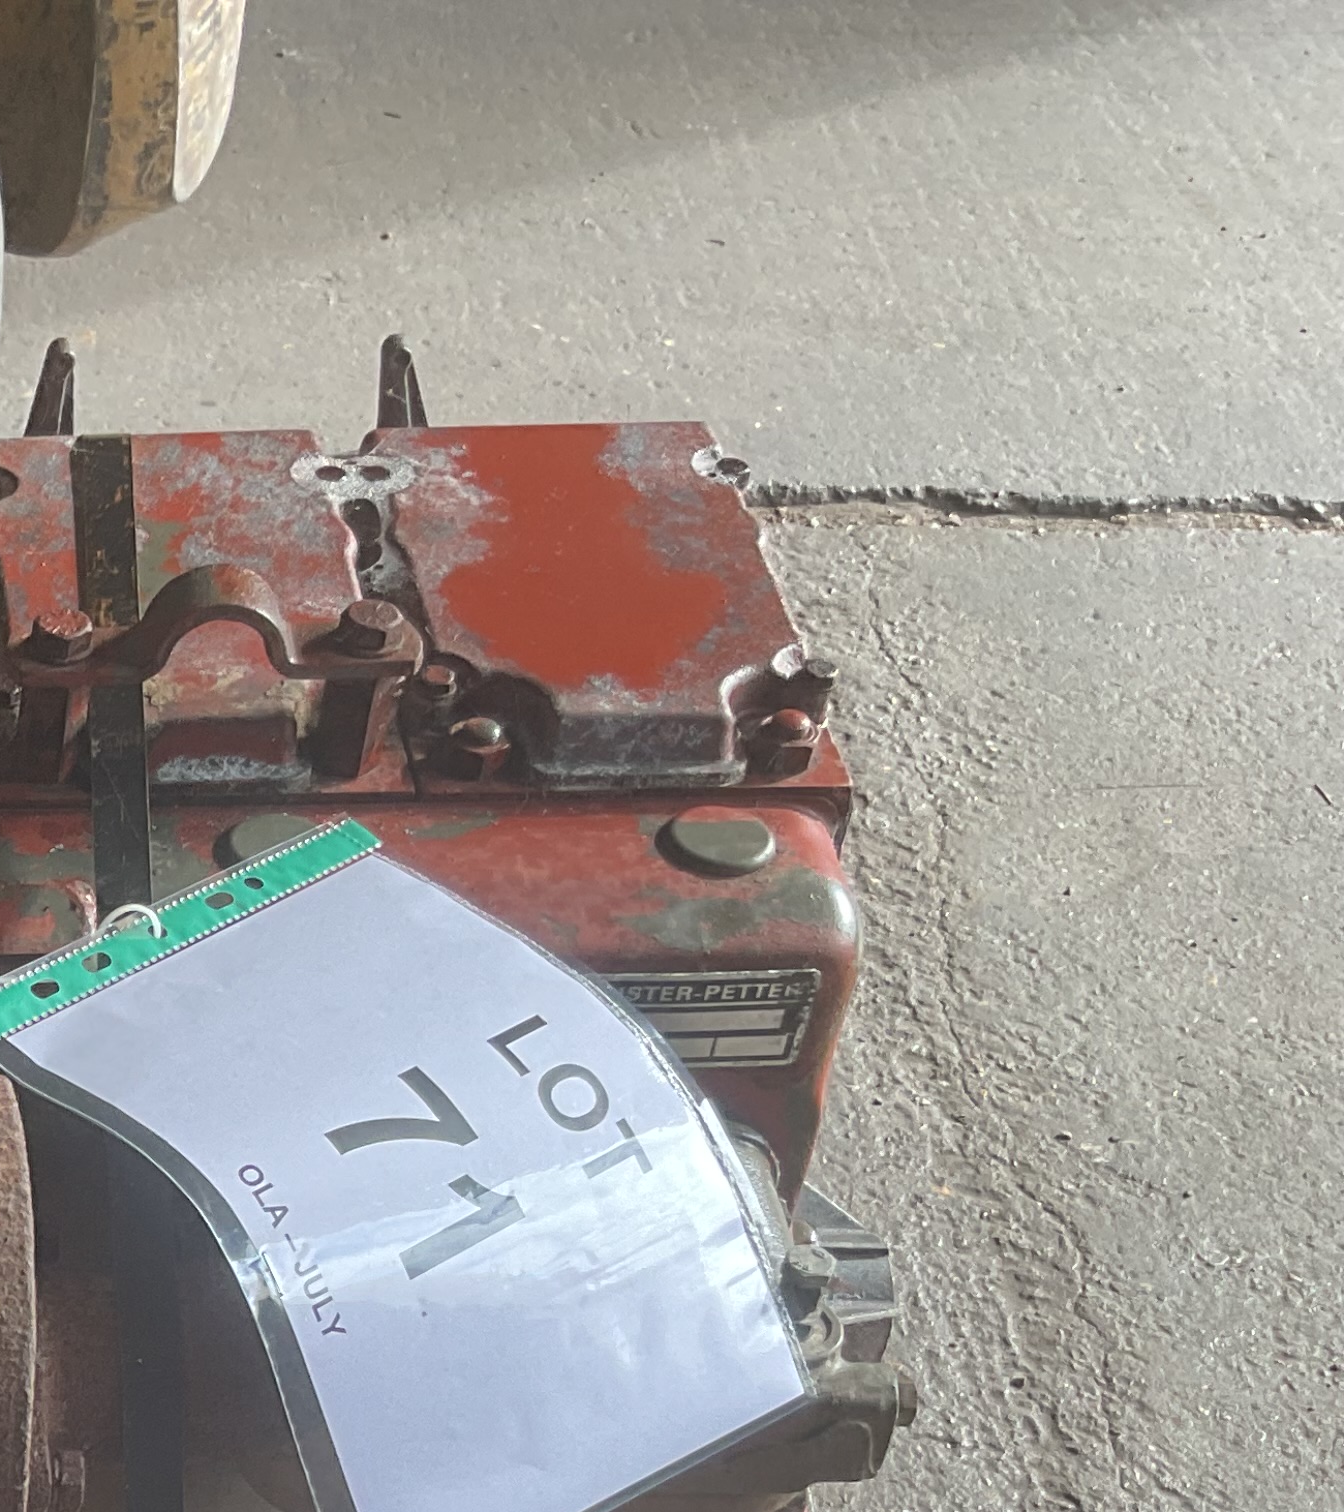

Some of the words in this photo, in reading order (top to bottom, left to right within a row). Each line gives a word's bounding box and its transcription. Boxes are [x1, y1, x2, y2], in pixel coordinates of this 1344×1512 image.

[323, 1065, 527, 1281] 71
[485, 1013, 654, 1180] LOT
[237, 1163, 290, 1229] OLA
[293, 1260, 348, 1337] JULY
